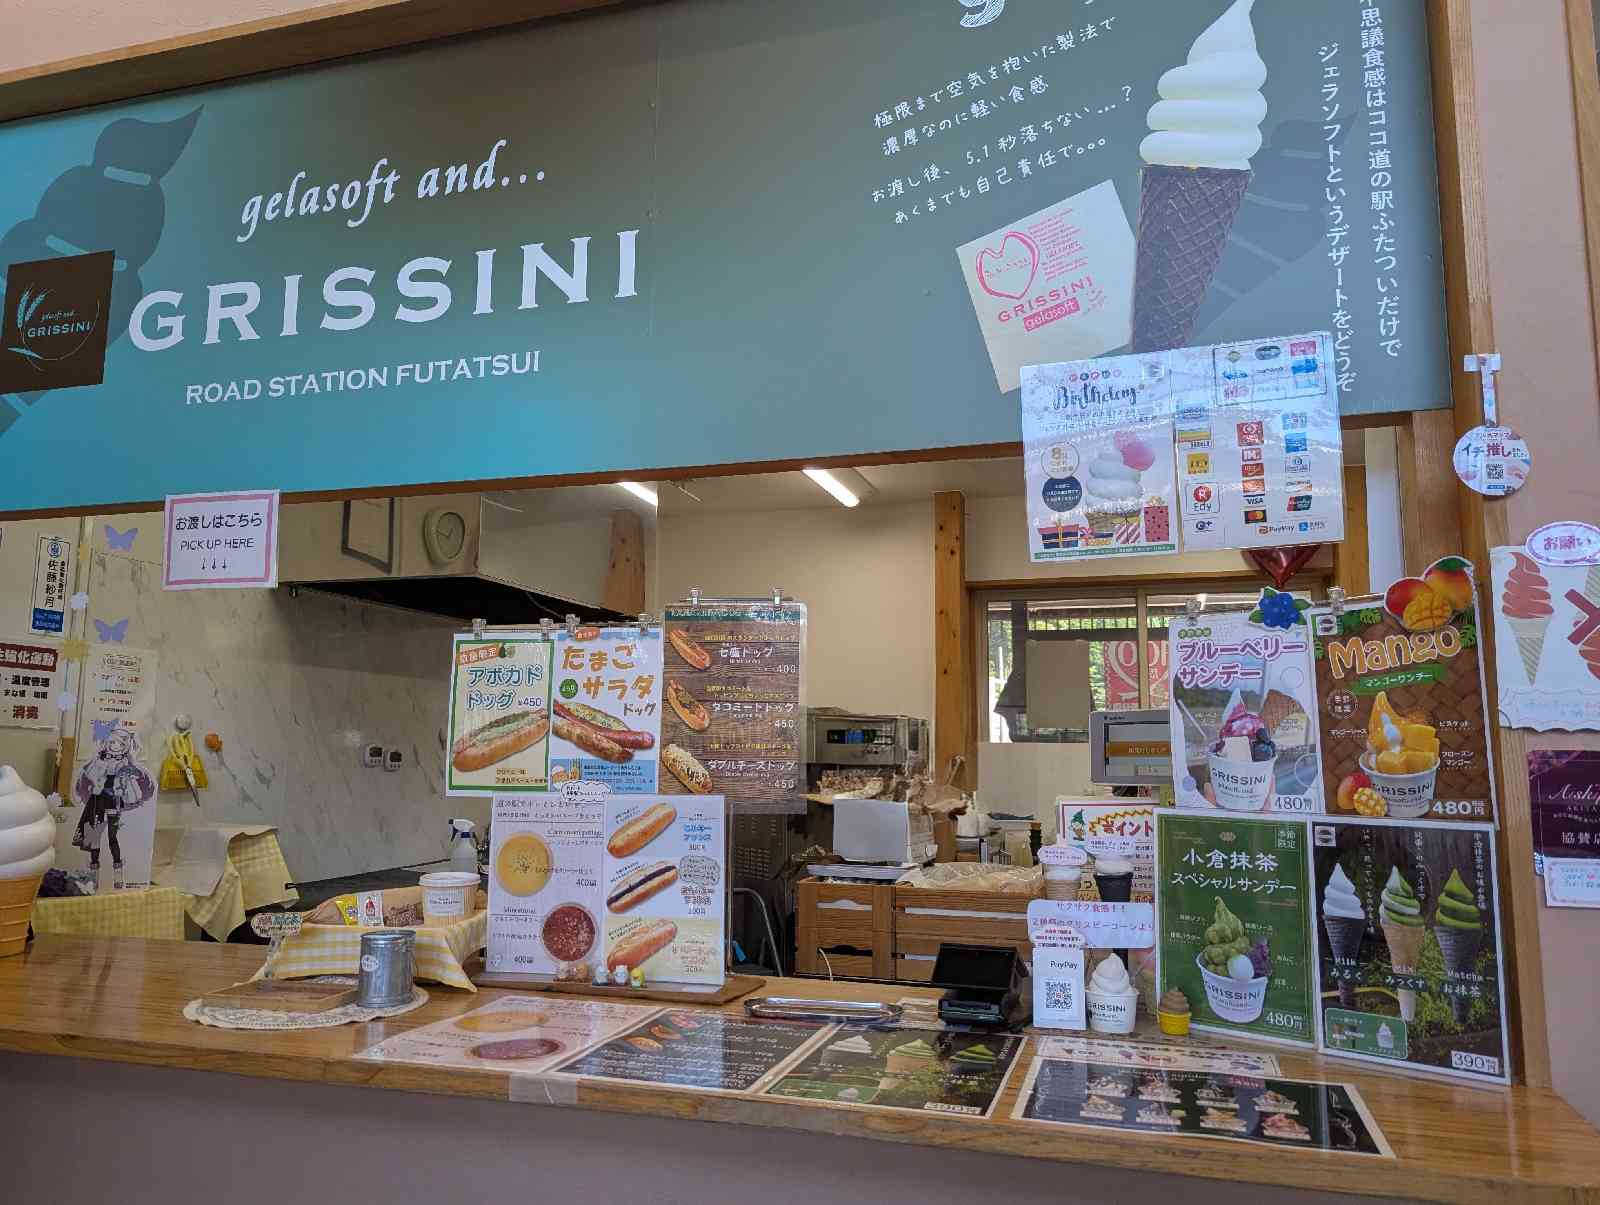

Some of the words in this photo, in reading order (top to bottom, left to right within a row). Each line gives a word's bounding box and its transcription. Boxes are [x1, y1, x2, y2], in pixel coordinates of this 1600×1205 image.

[873, 16, 1117, 128] 極限まで空気を抱いた製法で
[882, 75, 1049, 157] 濃厚なのに軽い食感
[1359, 0, 1403, 357] 思議食感はココ道の駅ふたついだけで
[236, 158, 401, 243] gelasoft
[1317, 42, 1357, 392] ジェラソフトというデザートをどうぞ
[128, 229, 640, 352] GRISSINI
[998, 275, 1093, 322] GRISSINI
[27, 321, 91, 338] GRISSINI
[185, 378, 262, 405] ROAD
[267, 367, 389, 399] STATION
[394, 350, 542, 385] FUTATSUI
[175, 511, 263, 531] お渡しはこちら
[180, 540, 204, 551] PICK
[206, 539, 221, 550] UP
[224, 537, 255, 549] HERE
[561, 645, 637, 673] たまご
[1178, 637, 1305, 664] ブルーベリー
[1328, 625, 1462, 679] Mango
[466, 664, 544, 688] アボカド
[582, 675, 658, 700] サラダ
[1179, 663, 1261, 688] サンデー
[465, 689, 517, 712] ドッグ
[1181, 848, 1280, 873] 小倉抹茶
[1170, 871, 1297, 895] スペシャルサンデー
[1050, 961, 1078, 970] PayPay
[1446, 969, 1483, 982] Matcha
[1444, 983, 1482, 998] お抹茶
